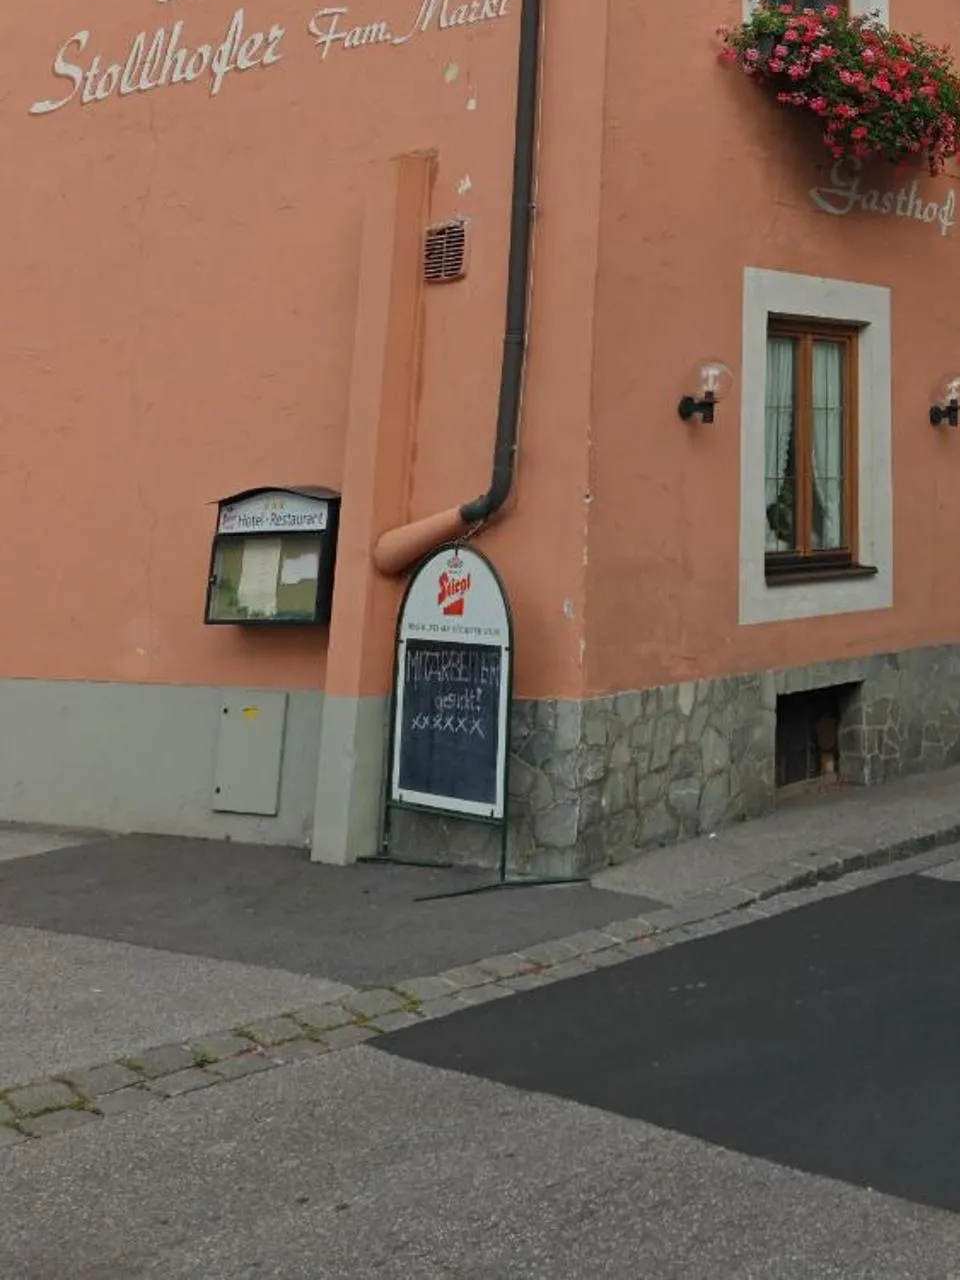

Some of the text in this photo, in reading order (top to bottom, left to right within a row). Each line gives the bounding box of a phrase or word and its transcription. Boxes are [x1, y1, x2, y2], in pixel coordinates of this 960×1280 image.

[28, 7, 286, 115] Stollhofer
[808, 156, 956, 237] Gasthof
[437, 571, 472, 606] Stiegl
